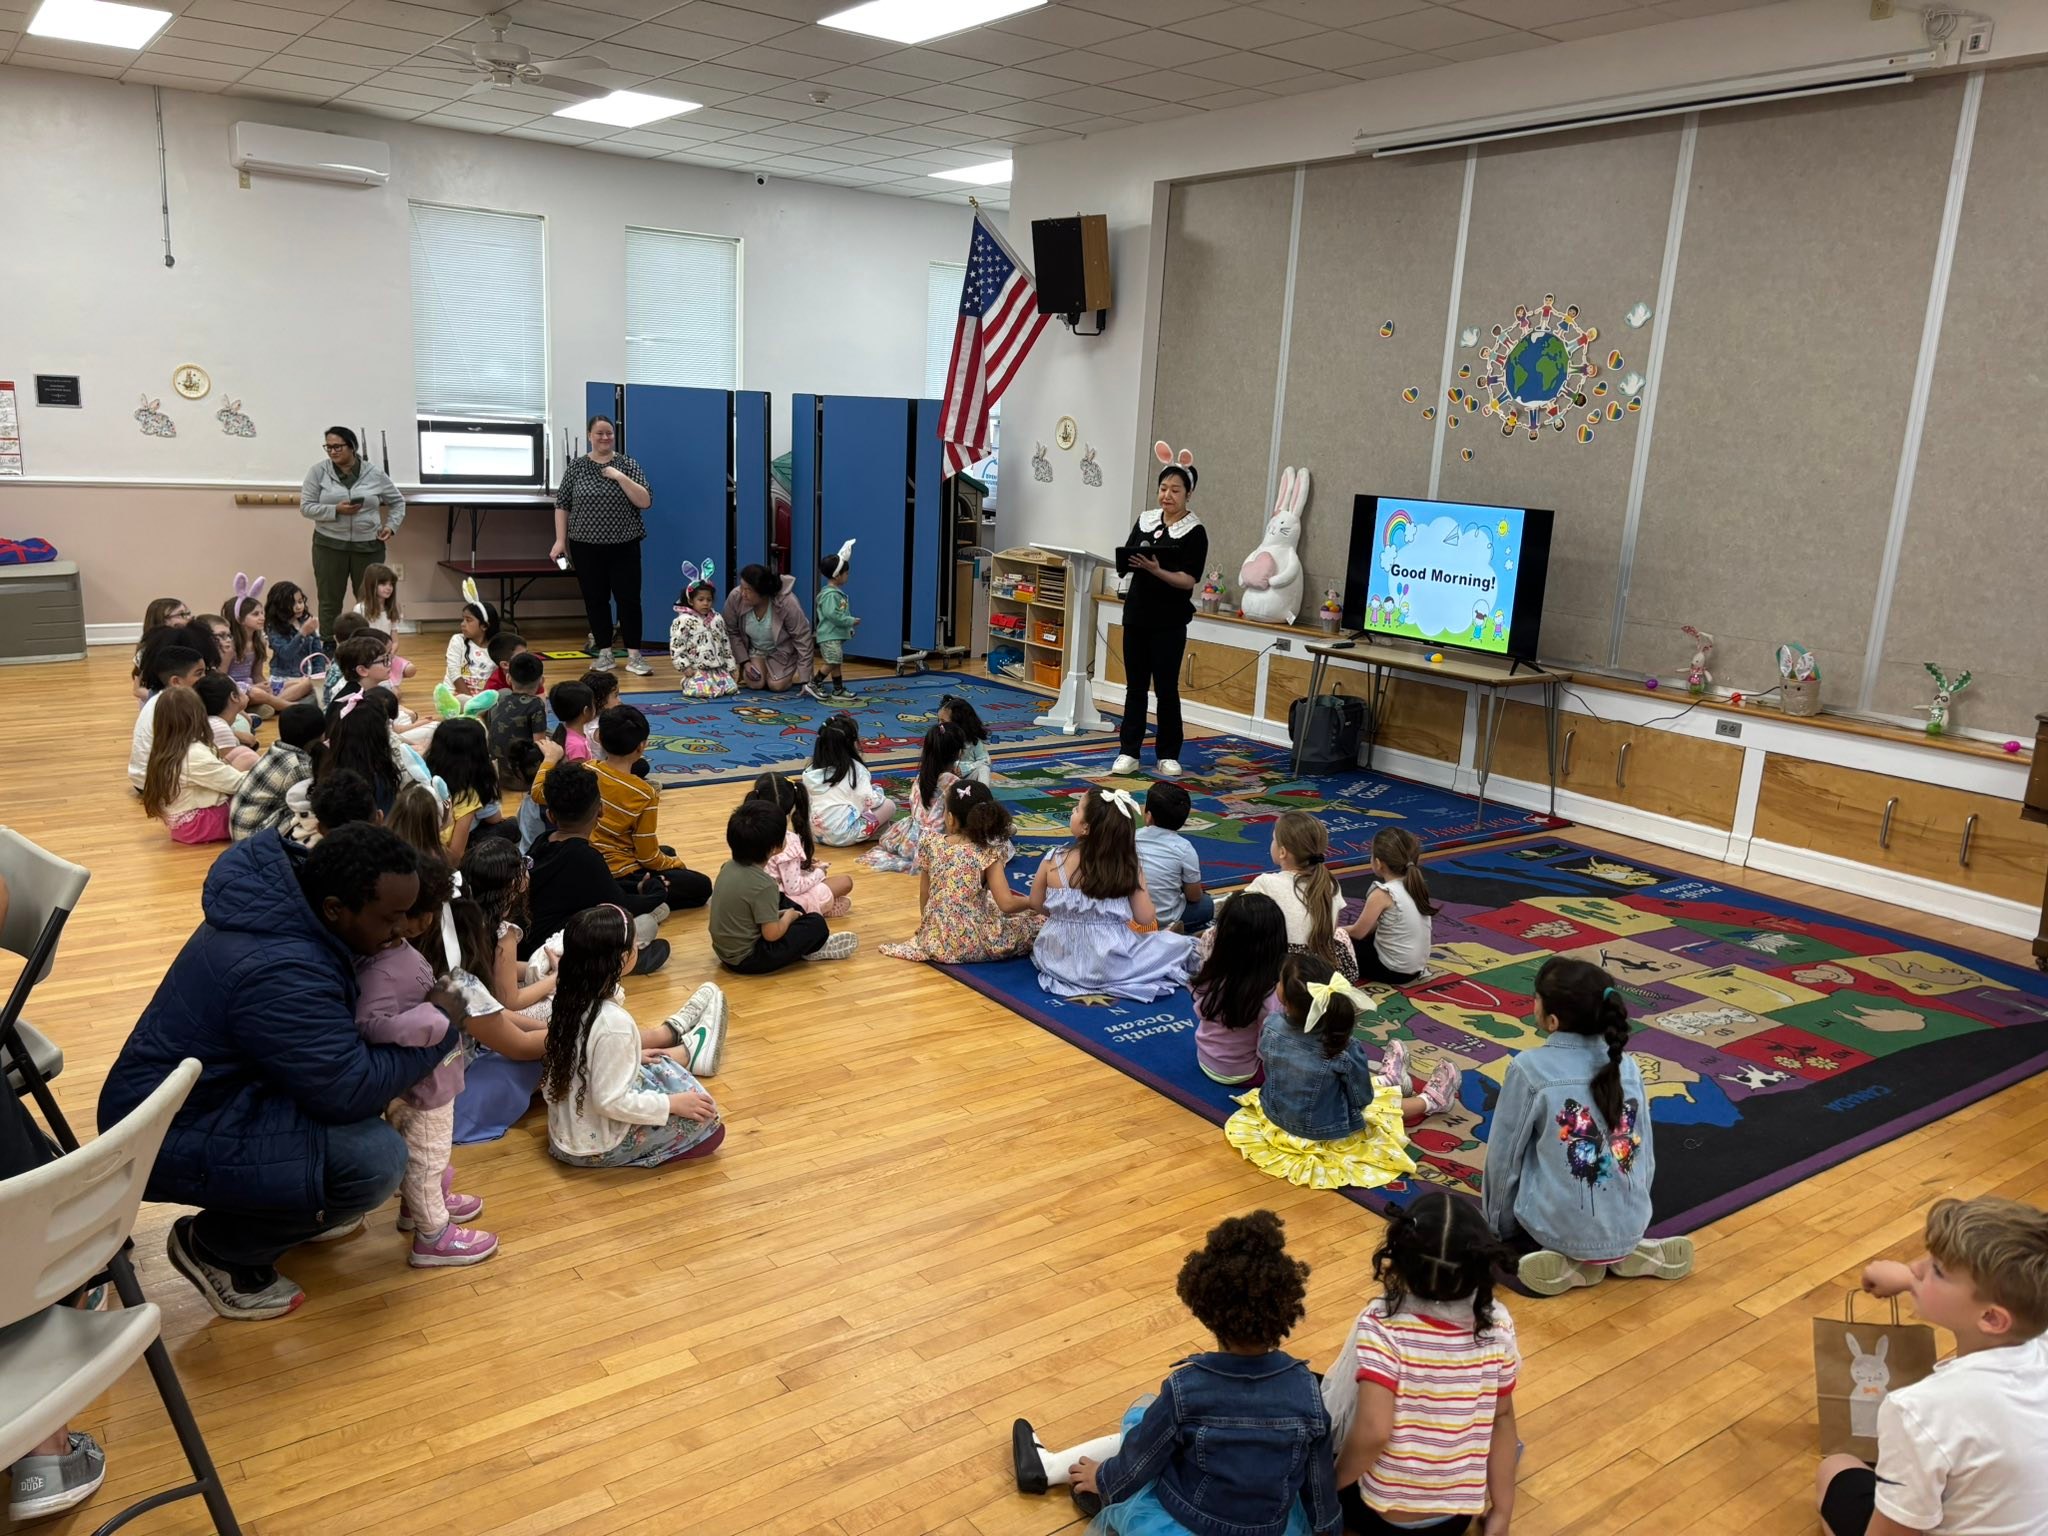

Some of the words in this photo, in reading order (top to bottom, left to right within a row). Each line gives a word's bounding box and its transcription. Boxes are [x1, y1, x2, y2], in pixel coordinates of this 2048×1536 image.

[1390, 564, 1426, 580] Good
[1431, 569, 1496, 591] Morning!
[1659, 882, 1703, 894] Ocean
[1107, 1006, 1130, 1016] N
[1104, 1013, 1175, 1033] Ocean
[1112, 1018, 1194, 1043] Atlantic
[1413, 1046, 1438, 1056] OH
[1443, 1115, 1468, 1127] NY
[21, 1478, 44, 1492] DUDE
